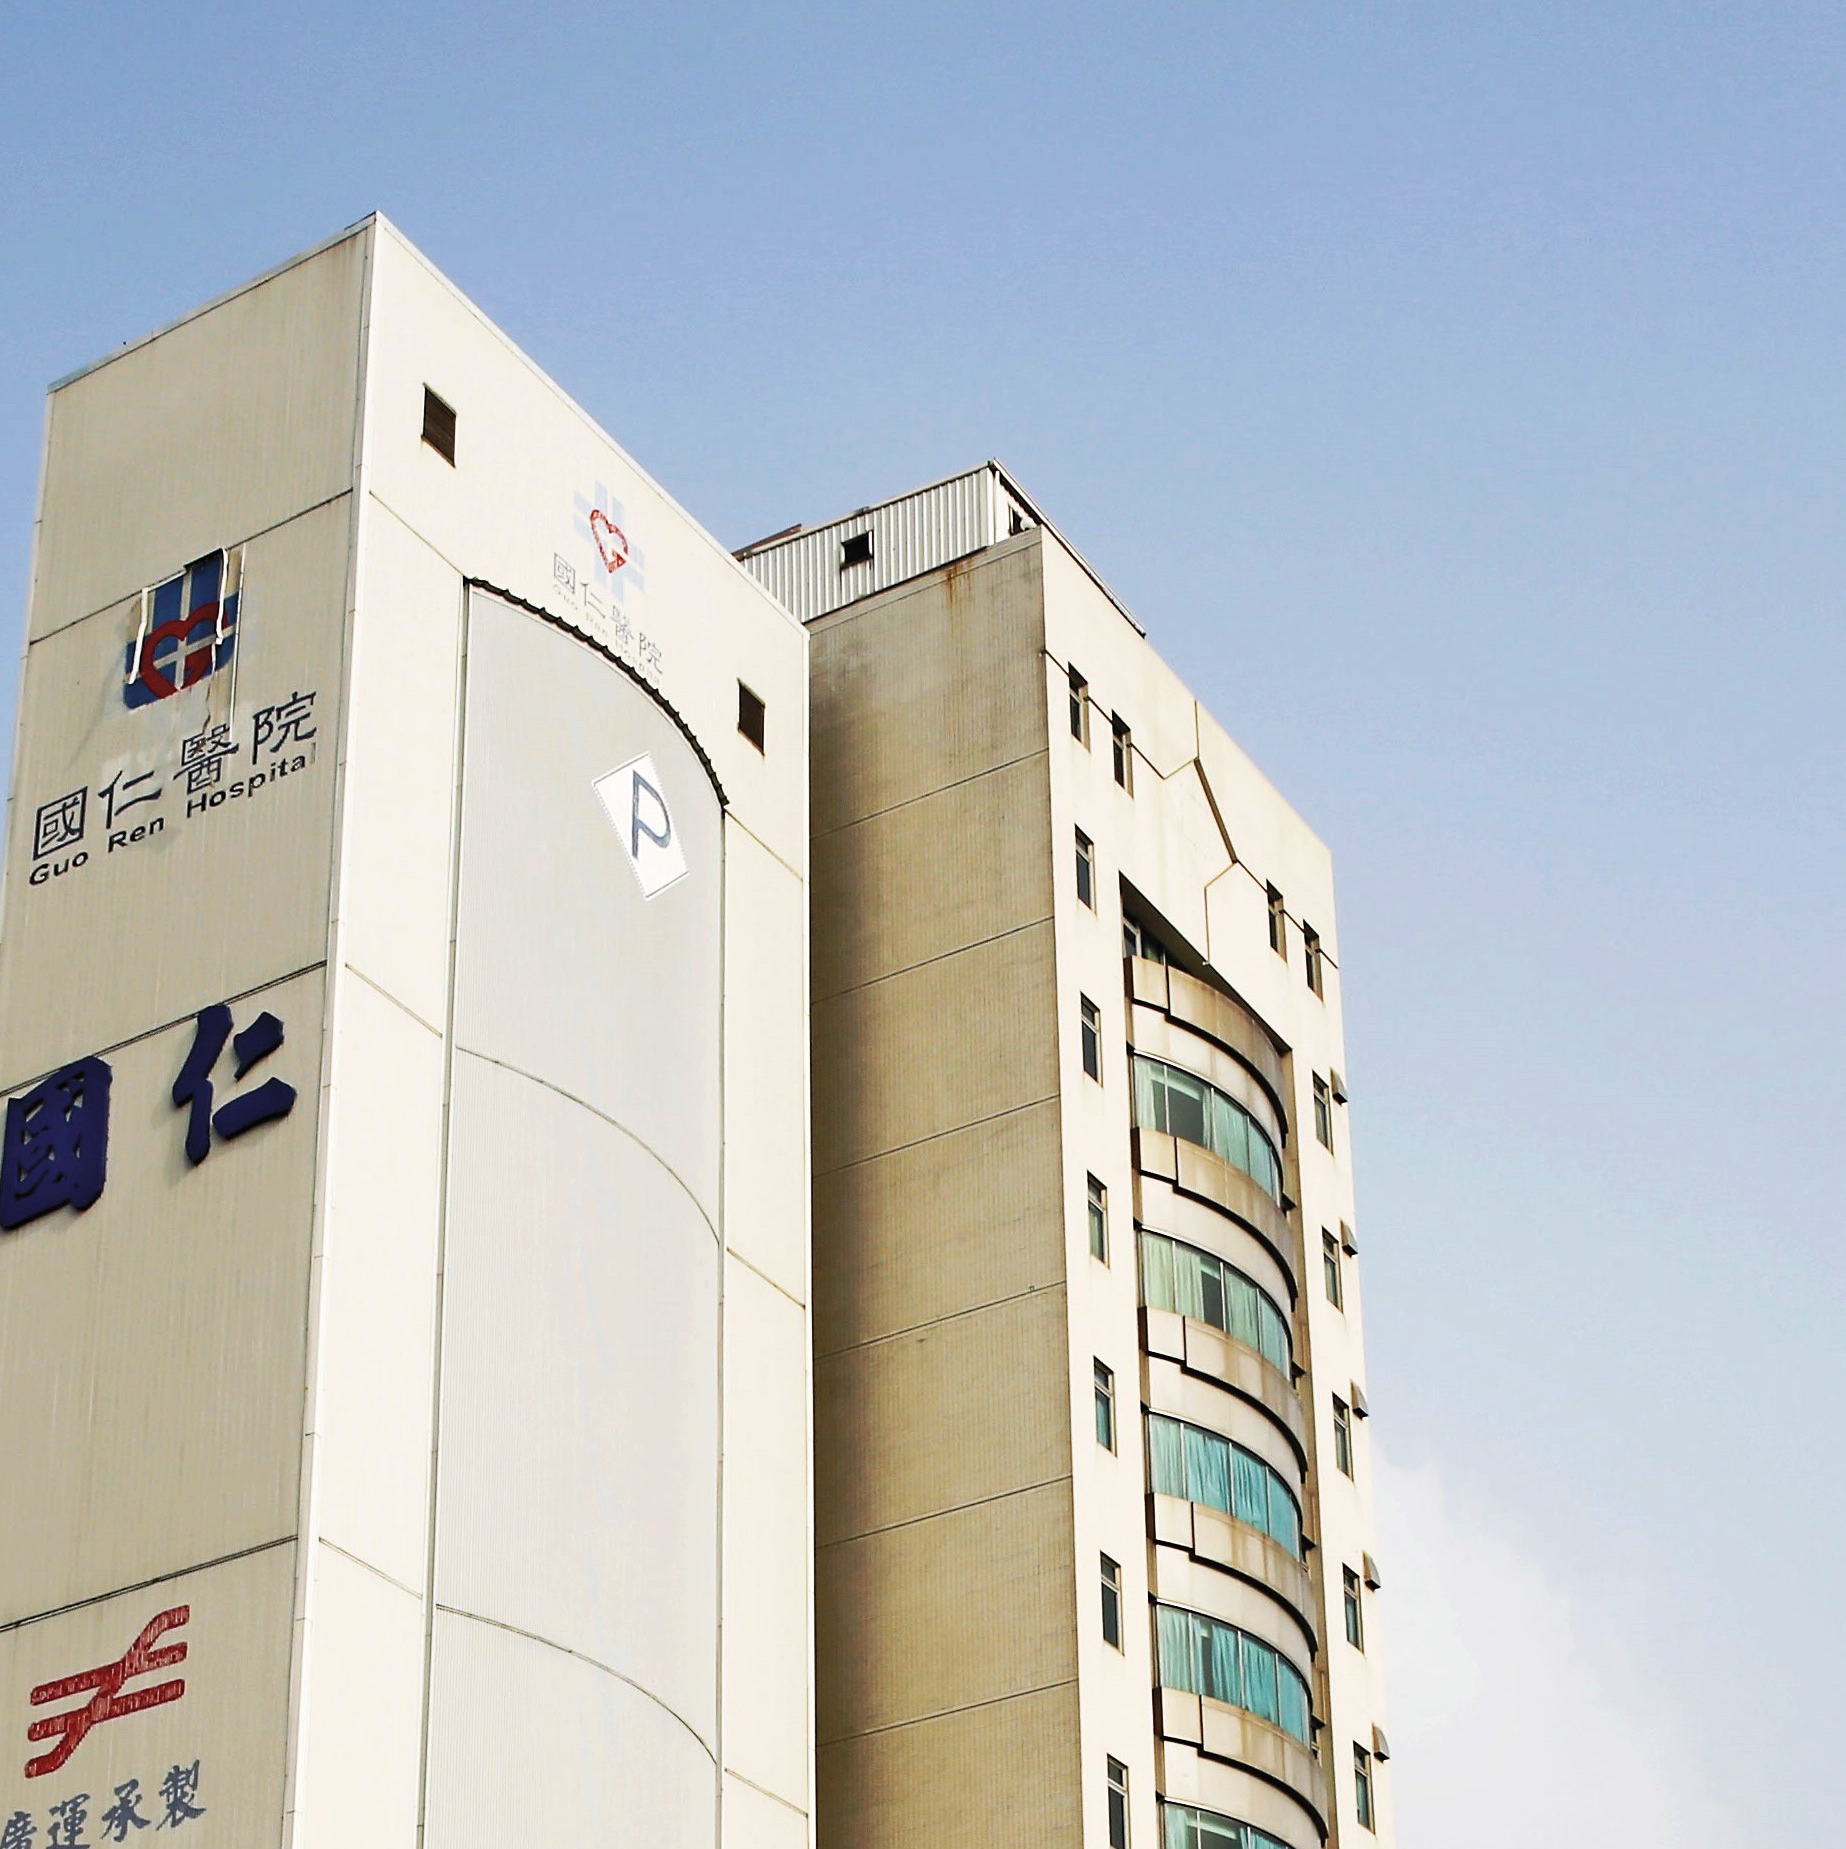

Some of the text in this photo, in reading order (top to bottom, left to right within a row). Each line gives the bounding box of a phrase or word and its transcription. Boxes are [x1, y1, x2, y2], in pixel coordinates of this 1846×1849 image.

[554, 553, 663, 674] 國仁醫院
[29, 743, 317, 886] Guo Ren Hospital
[33, 689, 317, 860] 國仁醫院
[630, 769, 672, 859] P
